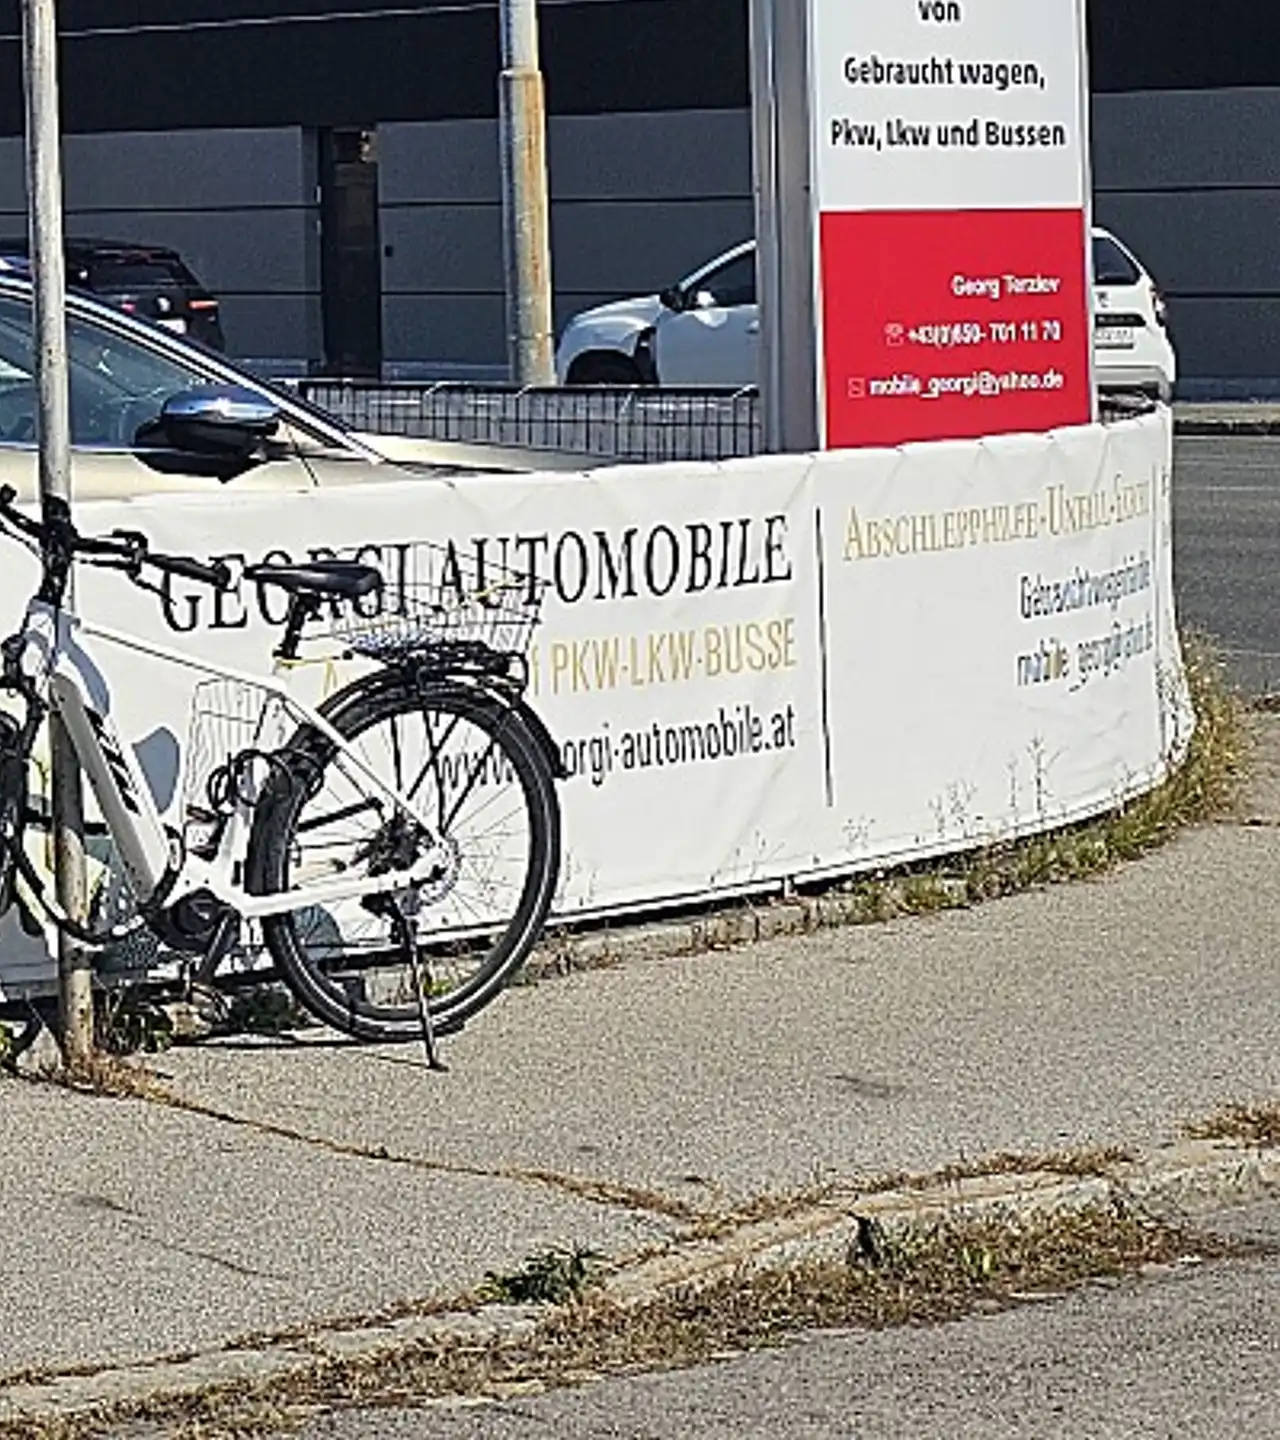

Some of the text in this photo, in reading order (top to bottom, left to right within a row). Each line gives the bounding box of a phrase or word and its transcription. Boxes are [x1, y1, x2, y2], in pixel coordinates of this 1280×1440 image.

[917, 0, 961, 23] von
[843, 57, 1045, 91] Gebraucht wagen,
[830, 118, 1066, 152] Pkw, Lkw und Bussen
[430, 515, 793, 610] AUTOMOBILE
